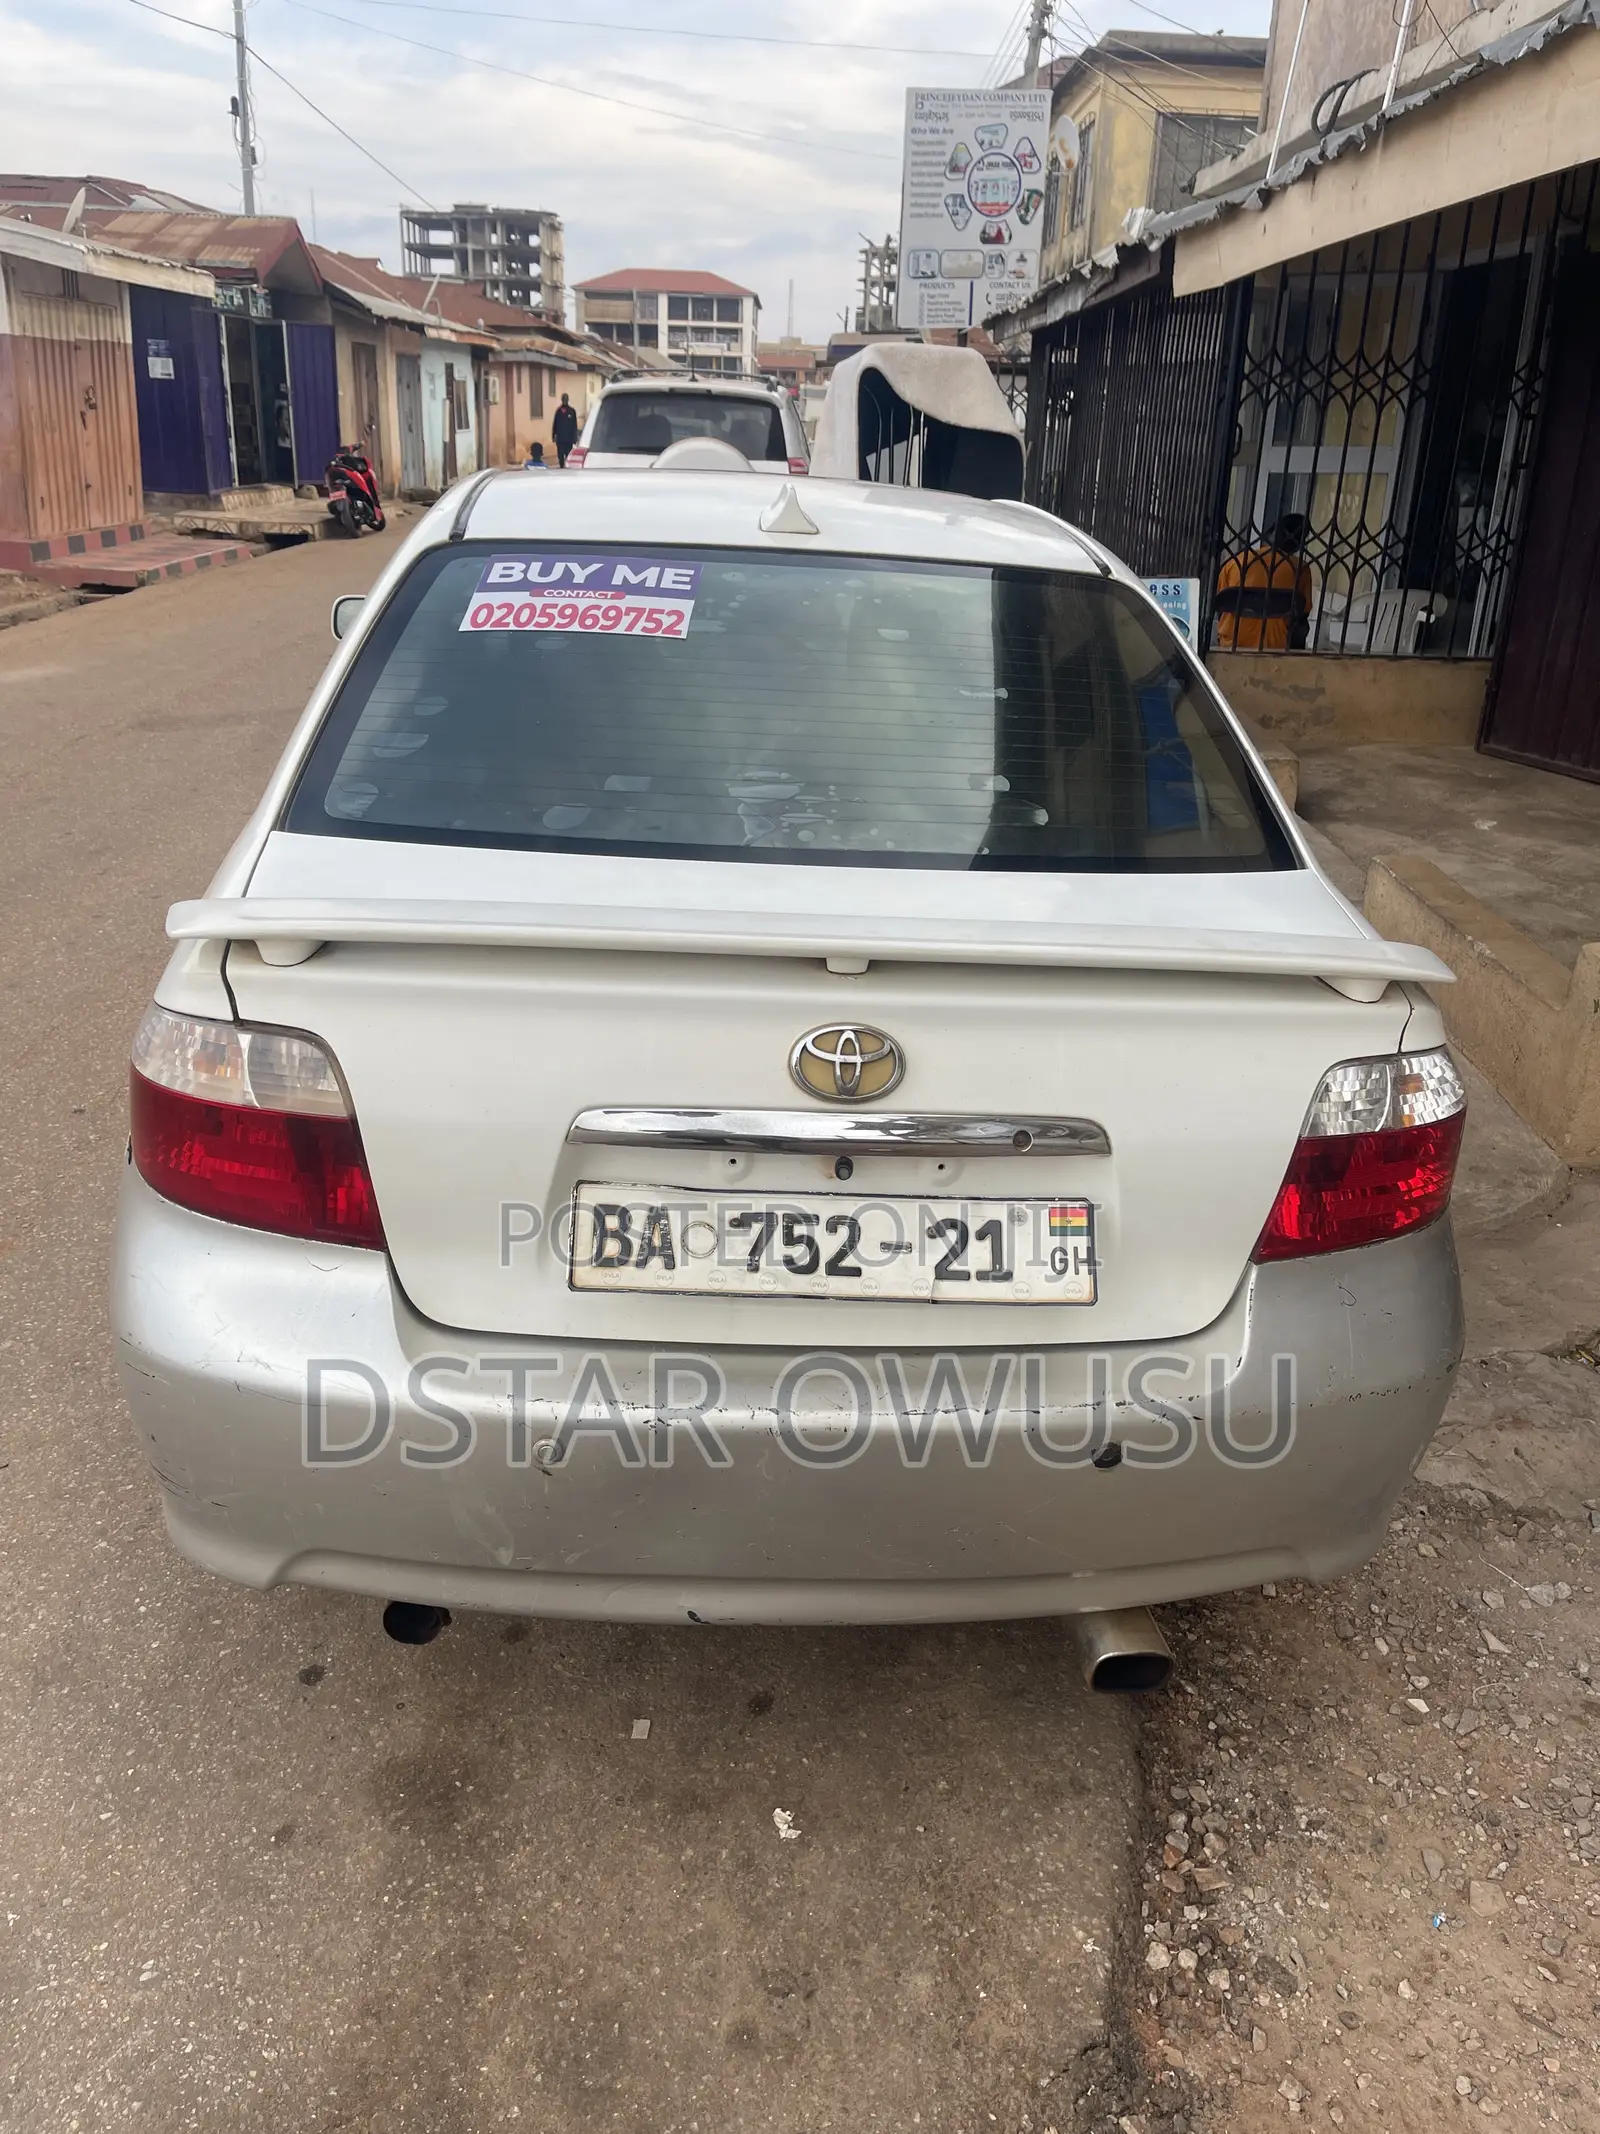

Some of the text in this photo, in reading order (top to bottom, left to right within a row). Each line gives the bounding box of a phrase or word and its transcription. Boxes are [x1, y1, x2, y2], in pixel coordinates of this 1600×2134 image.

[983, 93, 1028, 102] COMPANY
[929, 127, 940, 135] We
[919, 281, 955, 290] PRODUCTS
[989, 281, 1020, 289] CONTACT
[486, 561, 695, 591] BUY ME
[544, 589, 615, 599] CONTACT
[469, 602, 686, 636] 0205969752
[592, 1203, 676, 1270] BA
[730, 1211, 863, 1277] 752
[926, 1217, 1014, 1282] 21
[1050, 1245, 1094, 1276] GH
